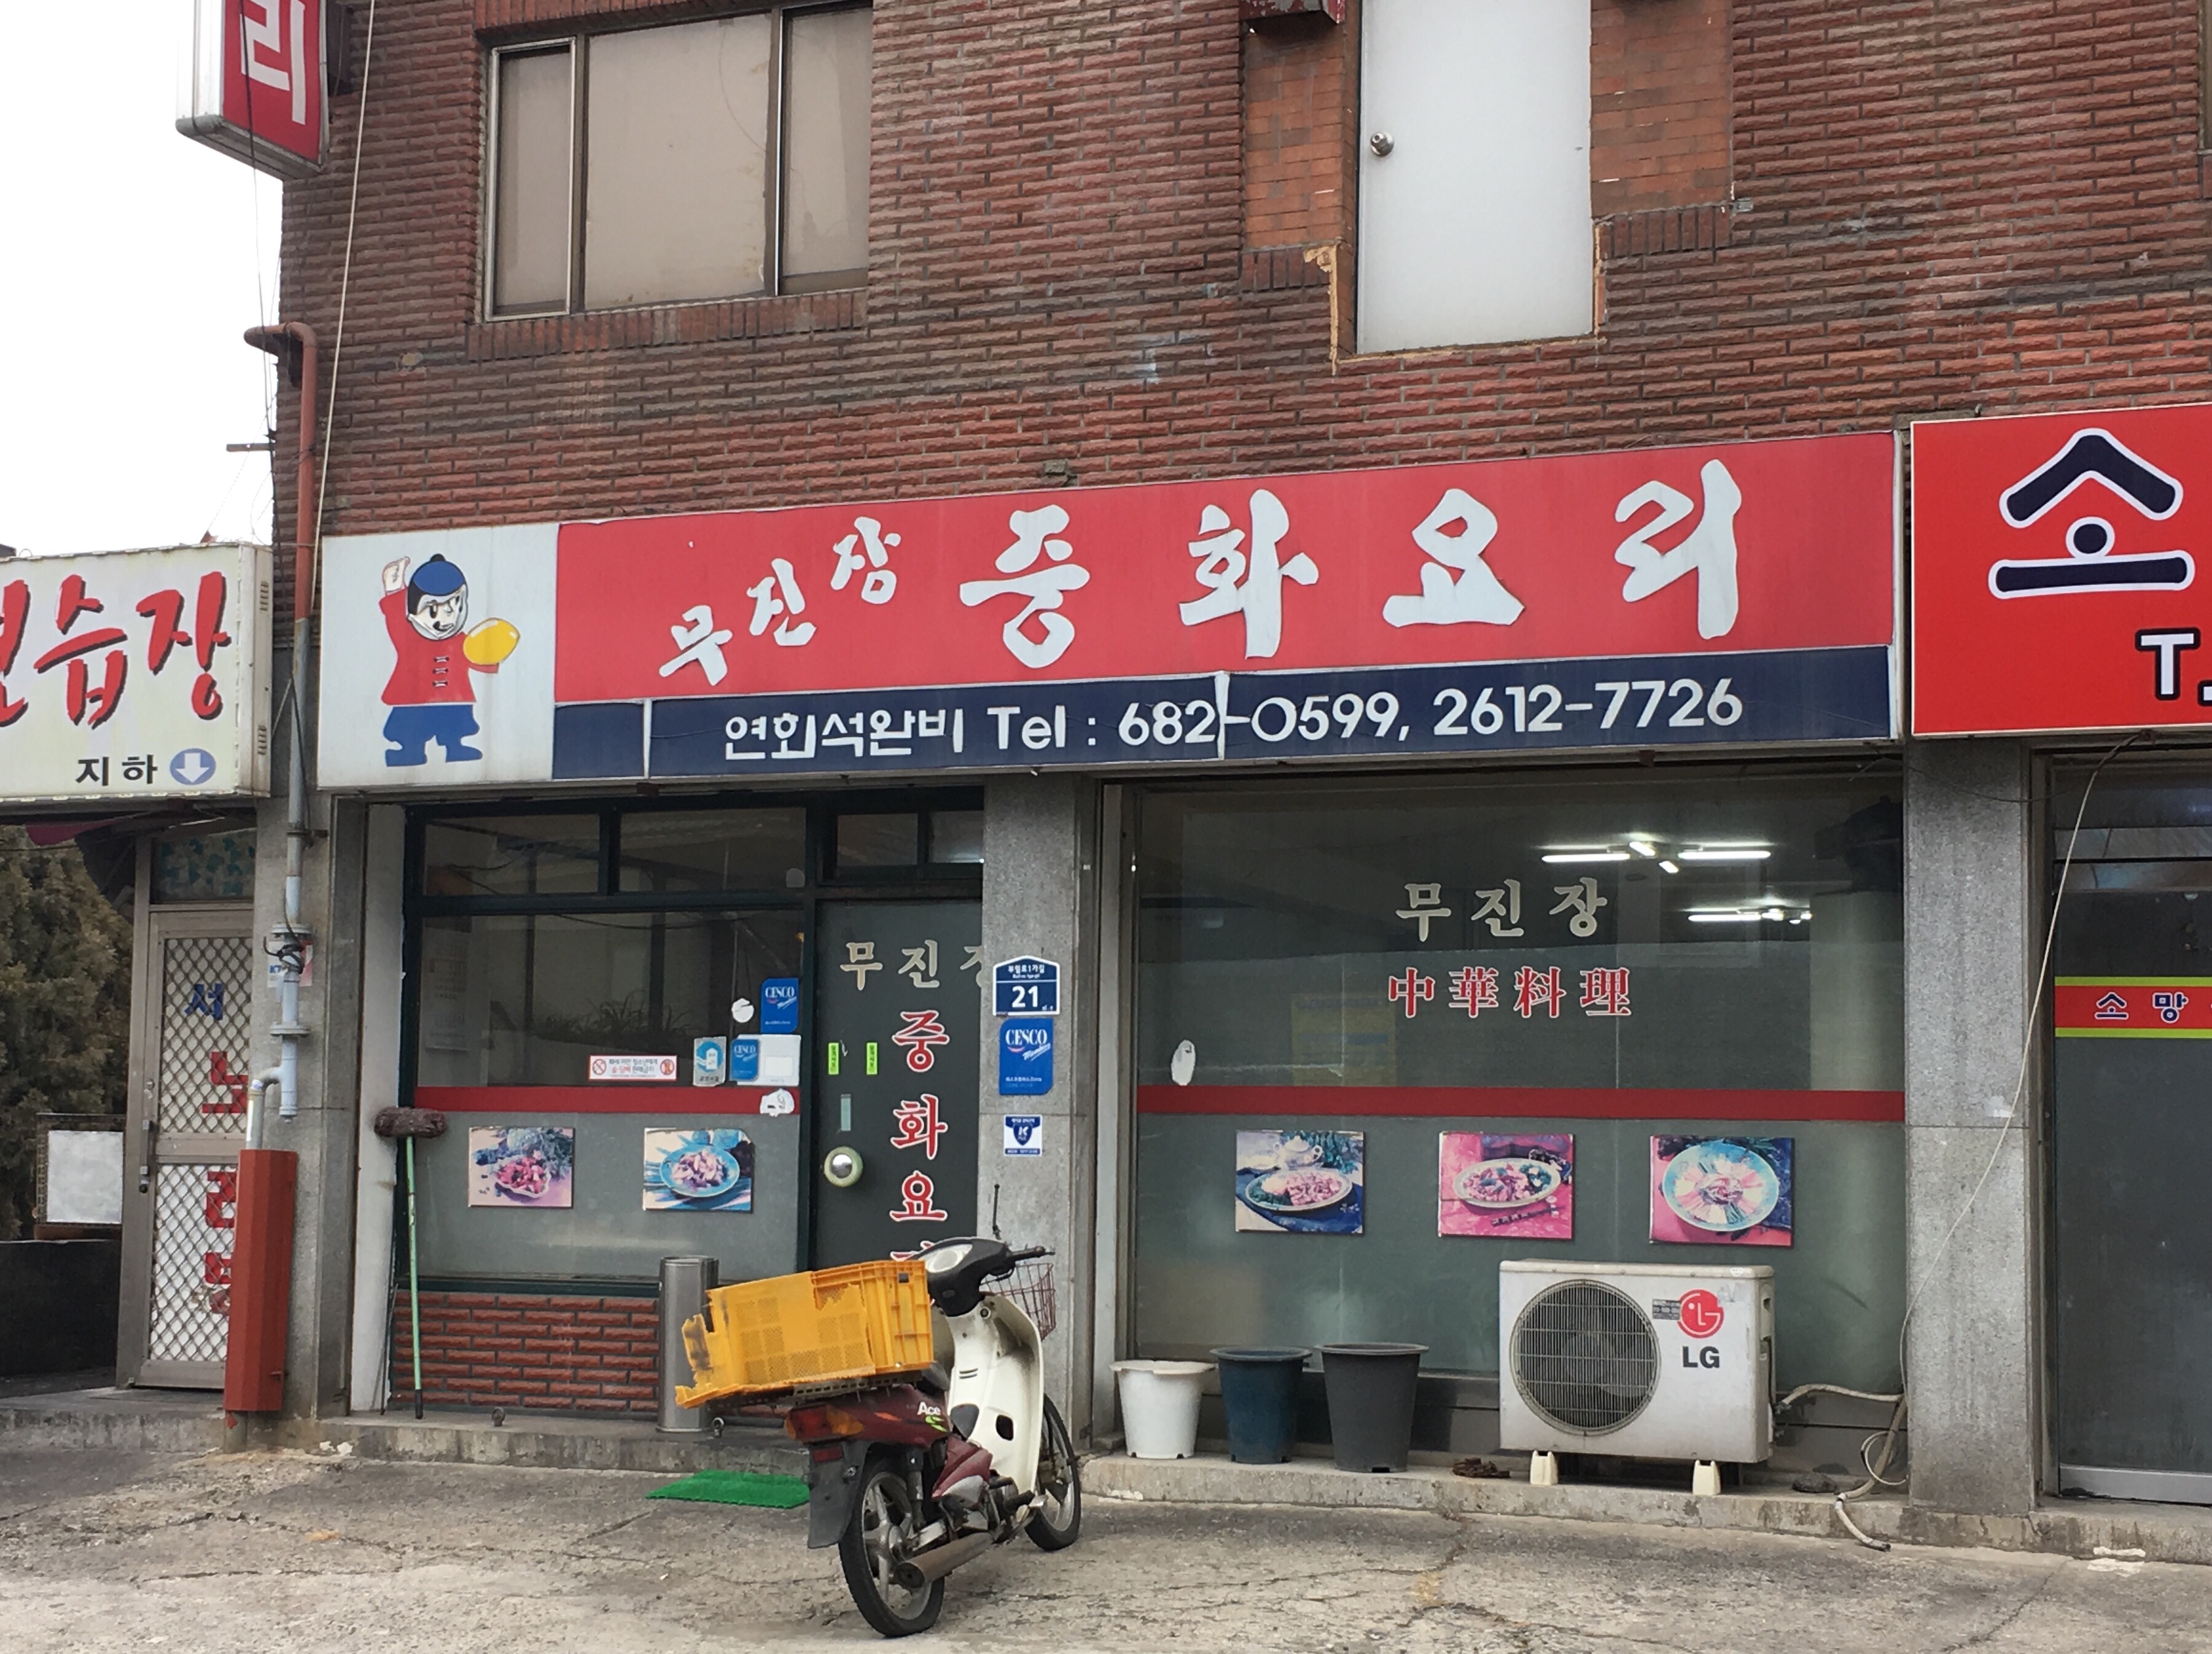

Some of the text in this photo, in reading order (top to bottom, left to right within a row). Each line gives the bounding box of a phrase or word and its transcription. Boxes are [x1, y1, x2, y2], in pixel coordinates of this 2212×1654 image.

[240, 0, 306, 125] 리
[1988, 428, 2195, 600] 소
[659, 458, 1742, 686] 무진장 중화요리
[725, 707, 964, 761] 연회석완비
[1433, 677, 1743, 737] 2612-7726
[76, 754, 158, 786] 지하
[1395, 876, 1608, 943] 무진장
[765, 986, 795, 998] CESCO
[1011, 985, 1039, 1008] 21
[1388, 966, 1632, 1019] 中華料理
[1005, 1028, 1048, 1046] CESCO
[889, 1010, 951, 1262] 중화요
[1682, 1345, 1720, 1369] LG
[917, 1401, 941, 1416] Ace
